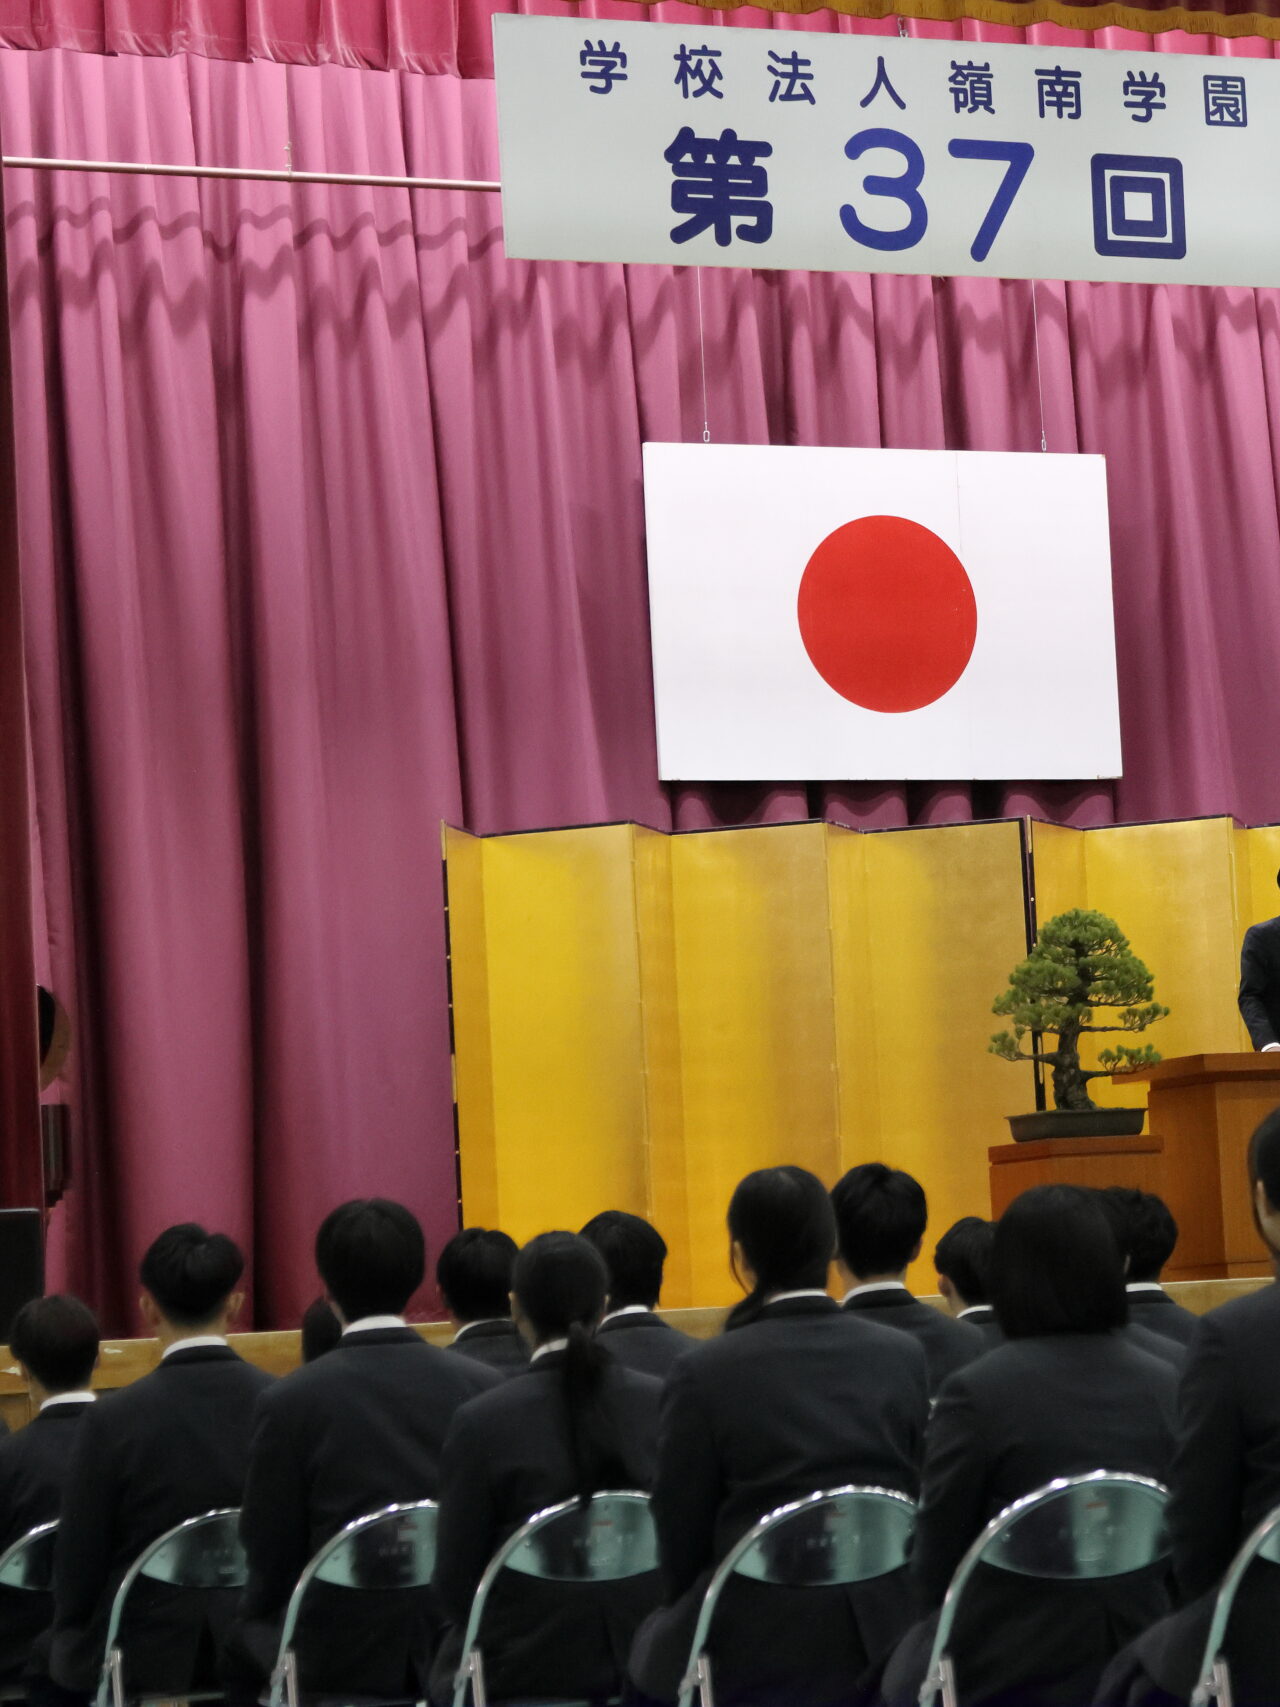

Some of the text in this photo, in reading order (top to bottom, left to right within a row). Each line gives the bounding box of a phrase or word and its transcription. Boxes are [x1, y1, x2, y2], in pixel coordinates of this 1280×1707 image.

[579, 39, 1248, 128] 学校法人嶺南学園
[664, 126, 1187, 262] 第37回
